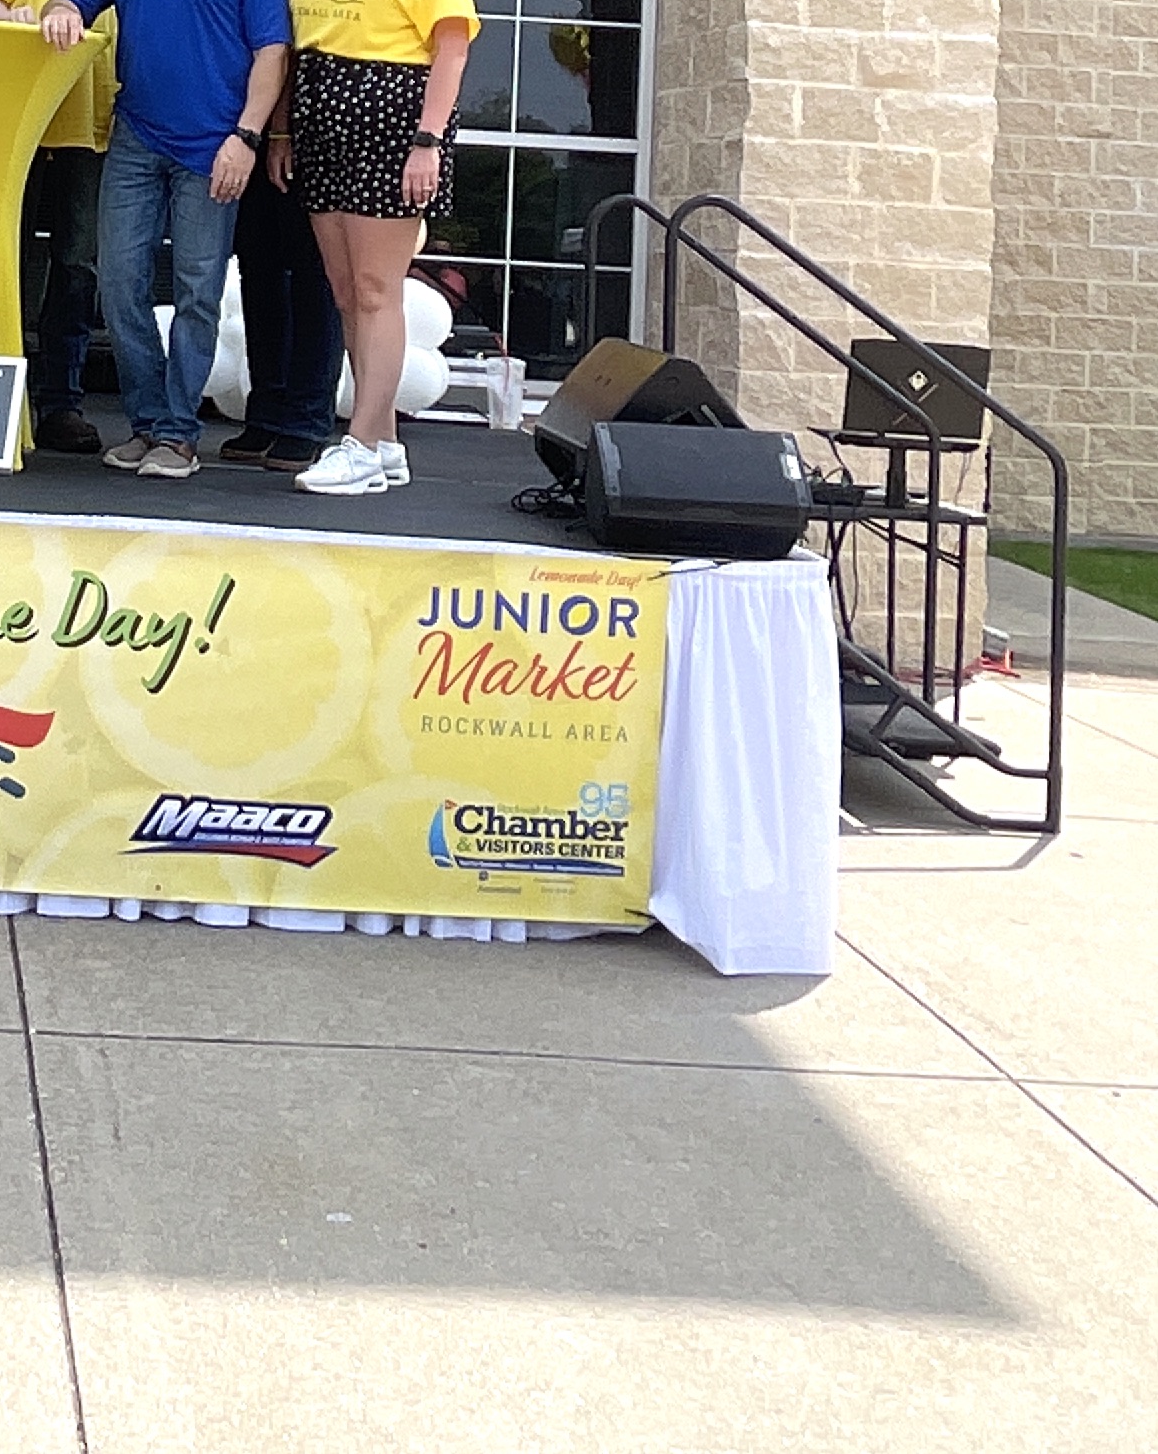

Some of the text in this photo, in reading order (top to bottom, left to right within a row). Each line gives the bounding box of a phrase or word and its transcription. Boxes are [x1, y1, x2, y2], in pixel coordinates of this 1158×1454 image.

[529, 566, 642, 591] Lemonade Day!
[417, 586, 640, 638] JUNIOR
[52, 569, 236, 694] Day!
[413, 630, 638, 705] Market
[420, 714, 629, 743] ROCKWALL AREA
[137, 795, 330, 839] Maaco
[579, 781, 630, 818] 95
[453, 804, 629, 841] Chamber
[456, 836, 626, 859] & VISITORS CENTER
